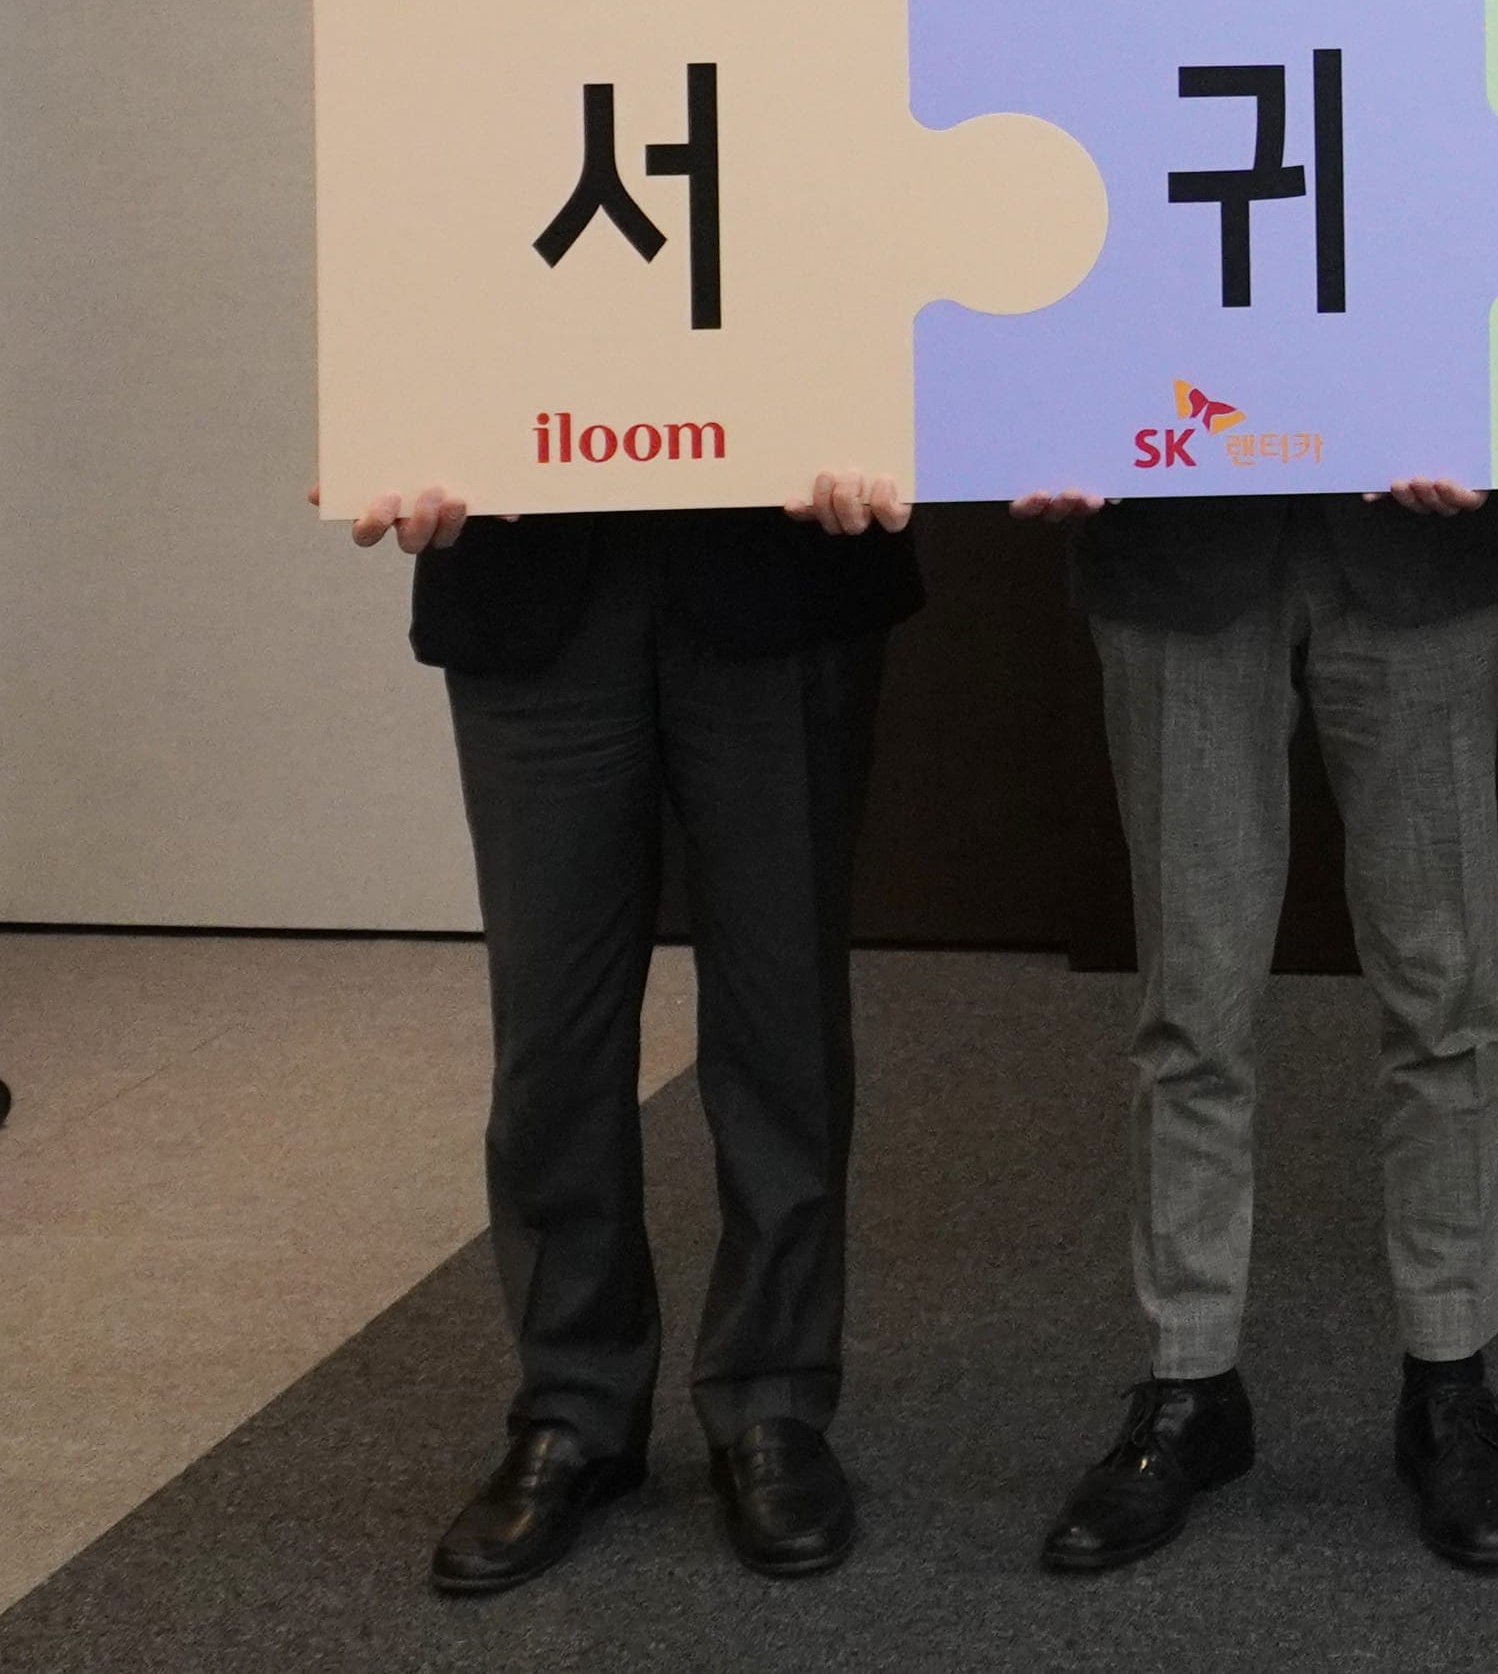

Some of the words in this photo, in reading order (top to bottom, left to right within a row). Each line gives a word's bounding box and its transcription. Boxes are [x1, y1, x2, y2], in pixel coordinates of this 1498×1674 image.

[532, 62, 724, 332] 서
[1168, 48, 1348, 315] 귀
[532, 411, 727, 466] iloom
[1133, 427, 1198, 469] SK
[1224, 430, 1325, 468] 렌터카
